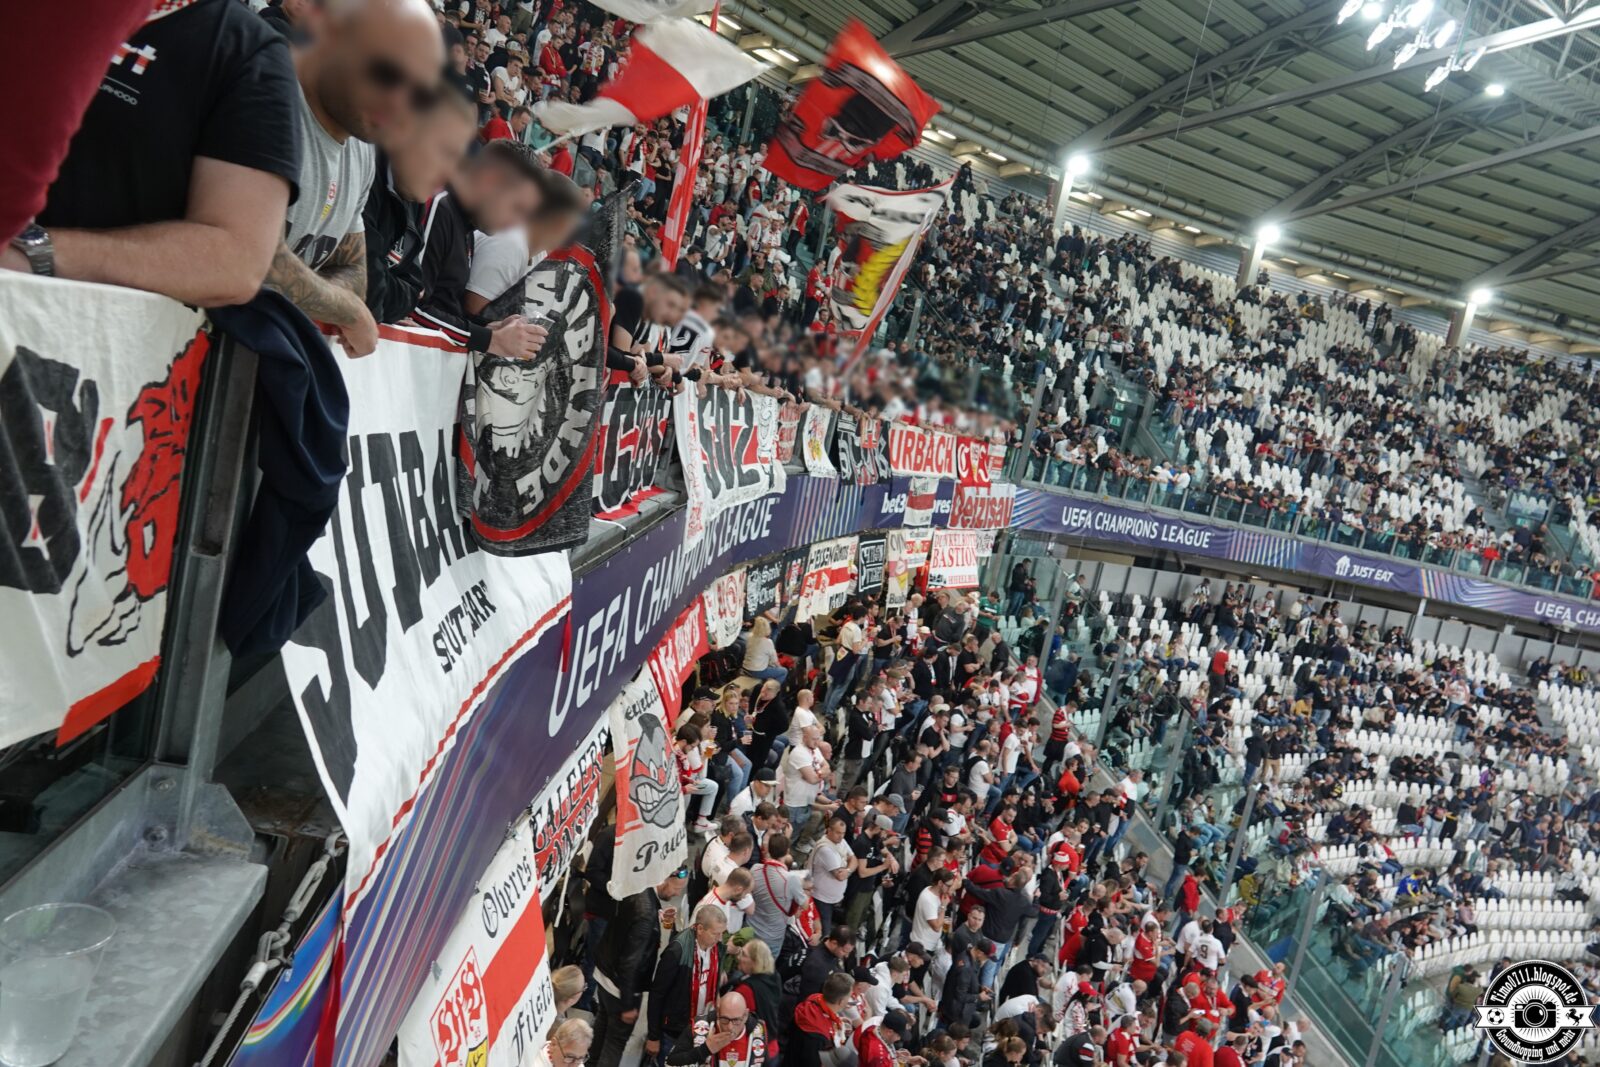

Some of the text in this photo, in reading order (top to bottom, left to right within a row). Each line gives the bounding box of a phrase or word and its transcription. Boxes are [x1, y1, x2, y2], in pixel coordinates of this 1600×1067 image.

[889, 428, 954, 474] URBACH
[881, 491, 906, 514] bet3
[1062, 506, 1213, 549] UEFA CHAMPIONS LEAGUE
[932, 547, 978, 569] BASTION
[1350, 564, 1394, 582] JUST EAT
[548, 587, 631, 738] UEFA
[633, 514, 721, 646] CHAMPIONS
[717, 497, 777, 558] LEAGUE
[1534, 600, 1600, 626] UEFA CHA
